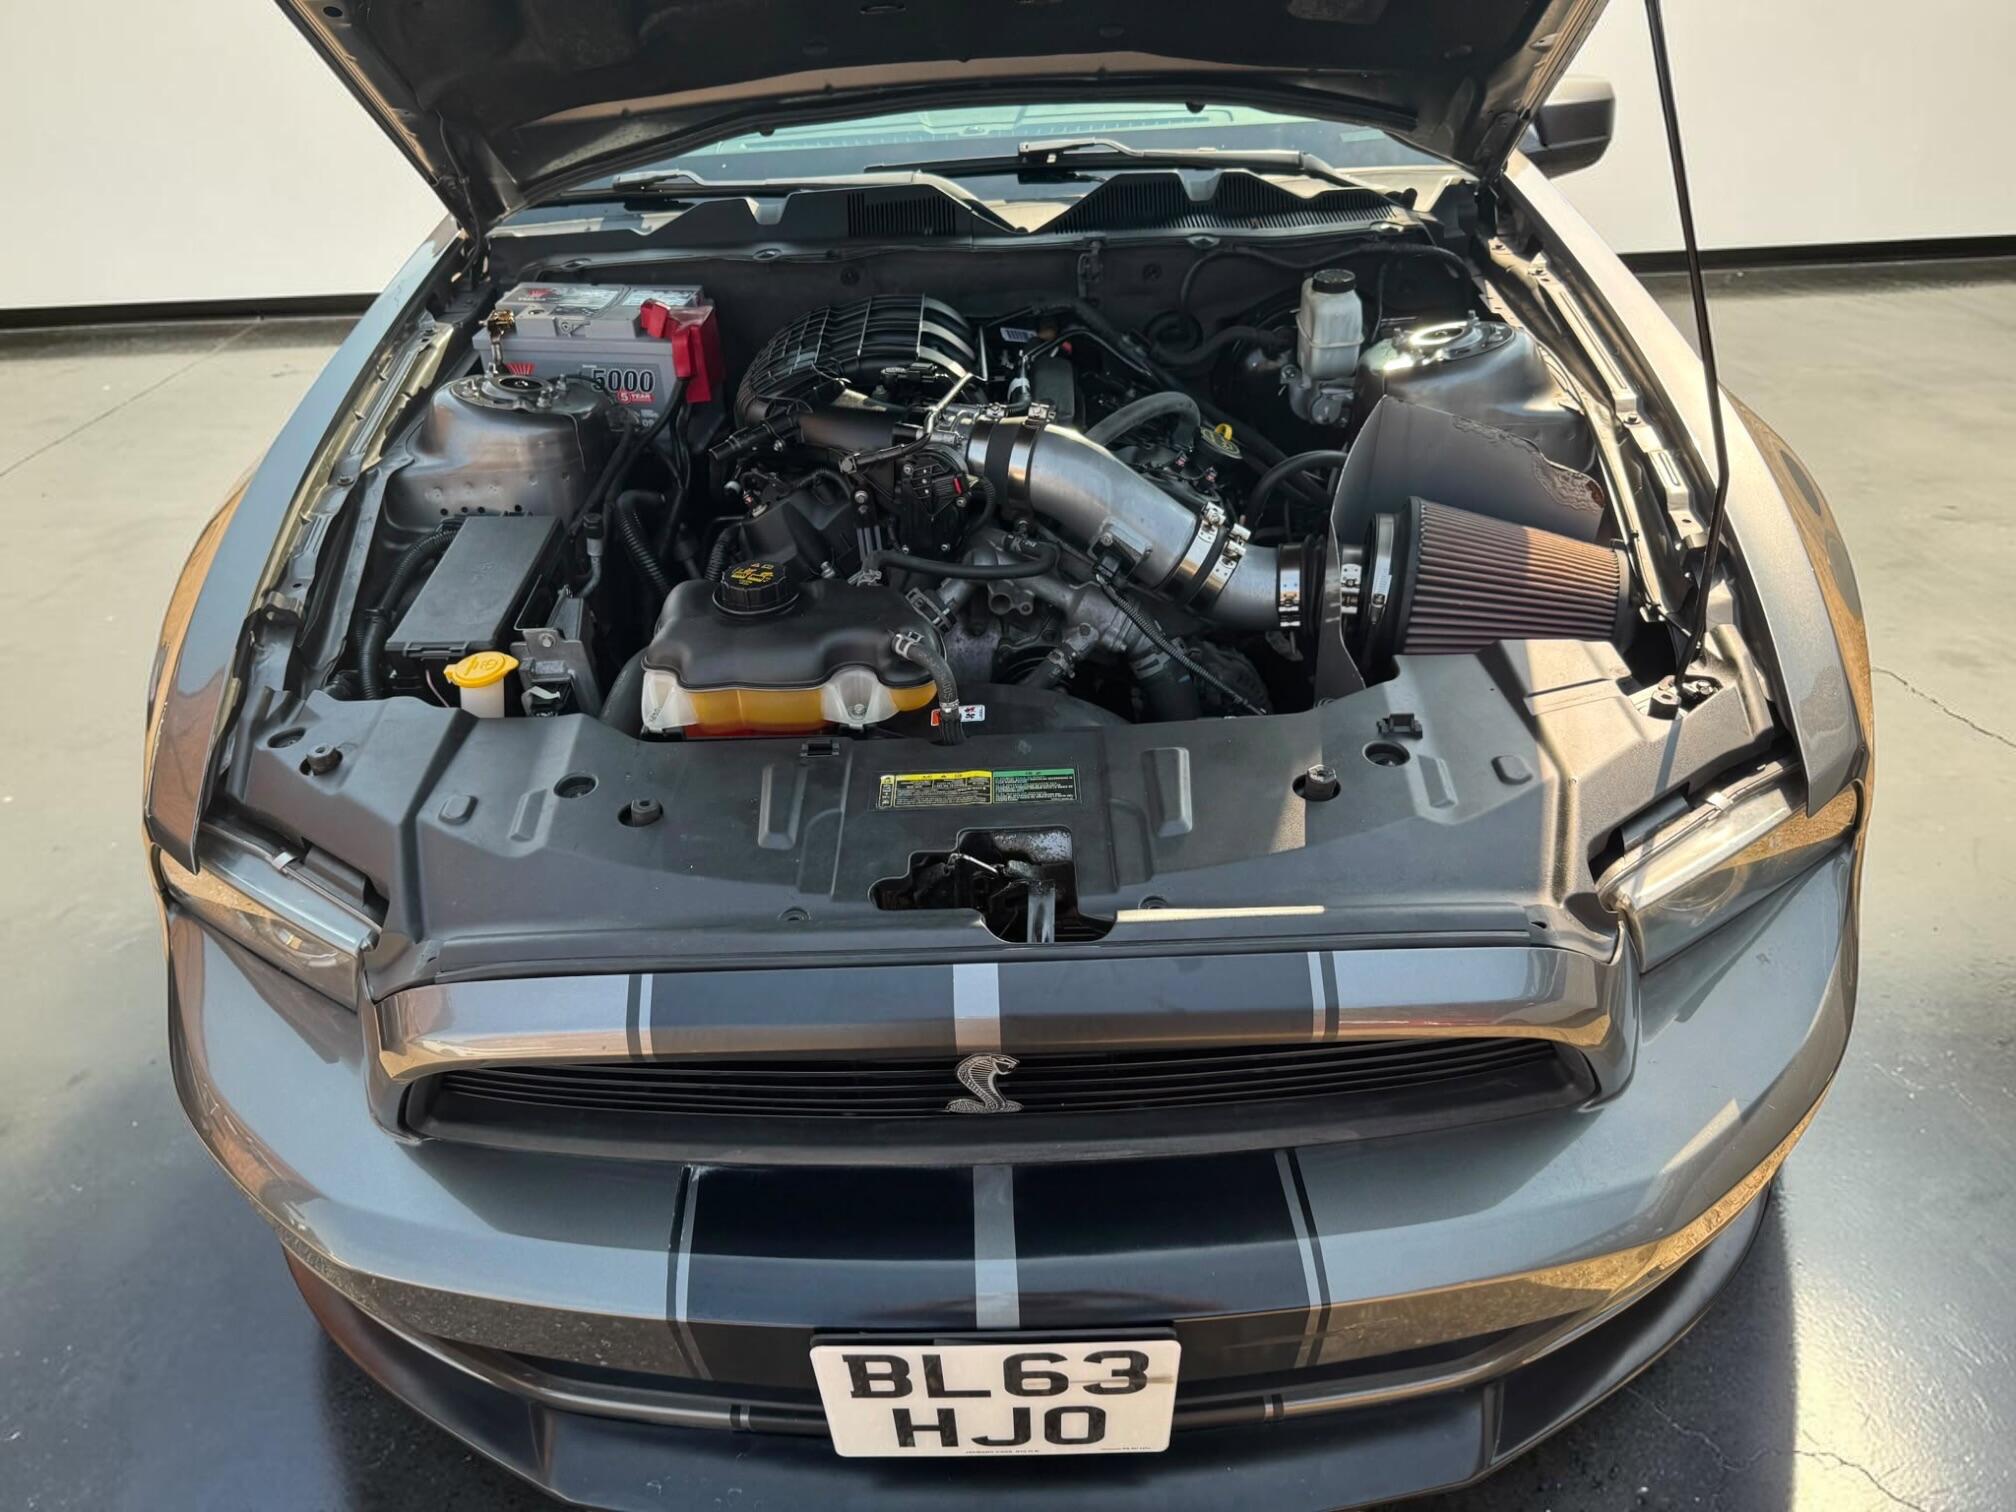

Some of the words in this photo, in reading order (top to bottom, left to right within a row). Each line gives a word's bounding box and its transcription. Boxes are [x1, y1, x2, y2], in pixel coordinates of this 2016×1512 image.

[592, 368, 655, 394] 5000
[842, 1350, 1150, 1398] BL63
[892, 1405, 1107, 1447] HJO
